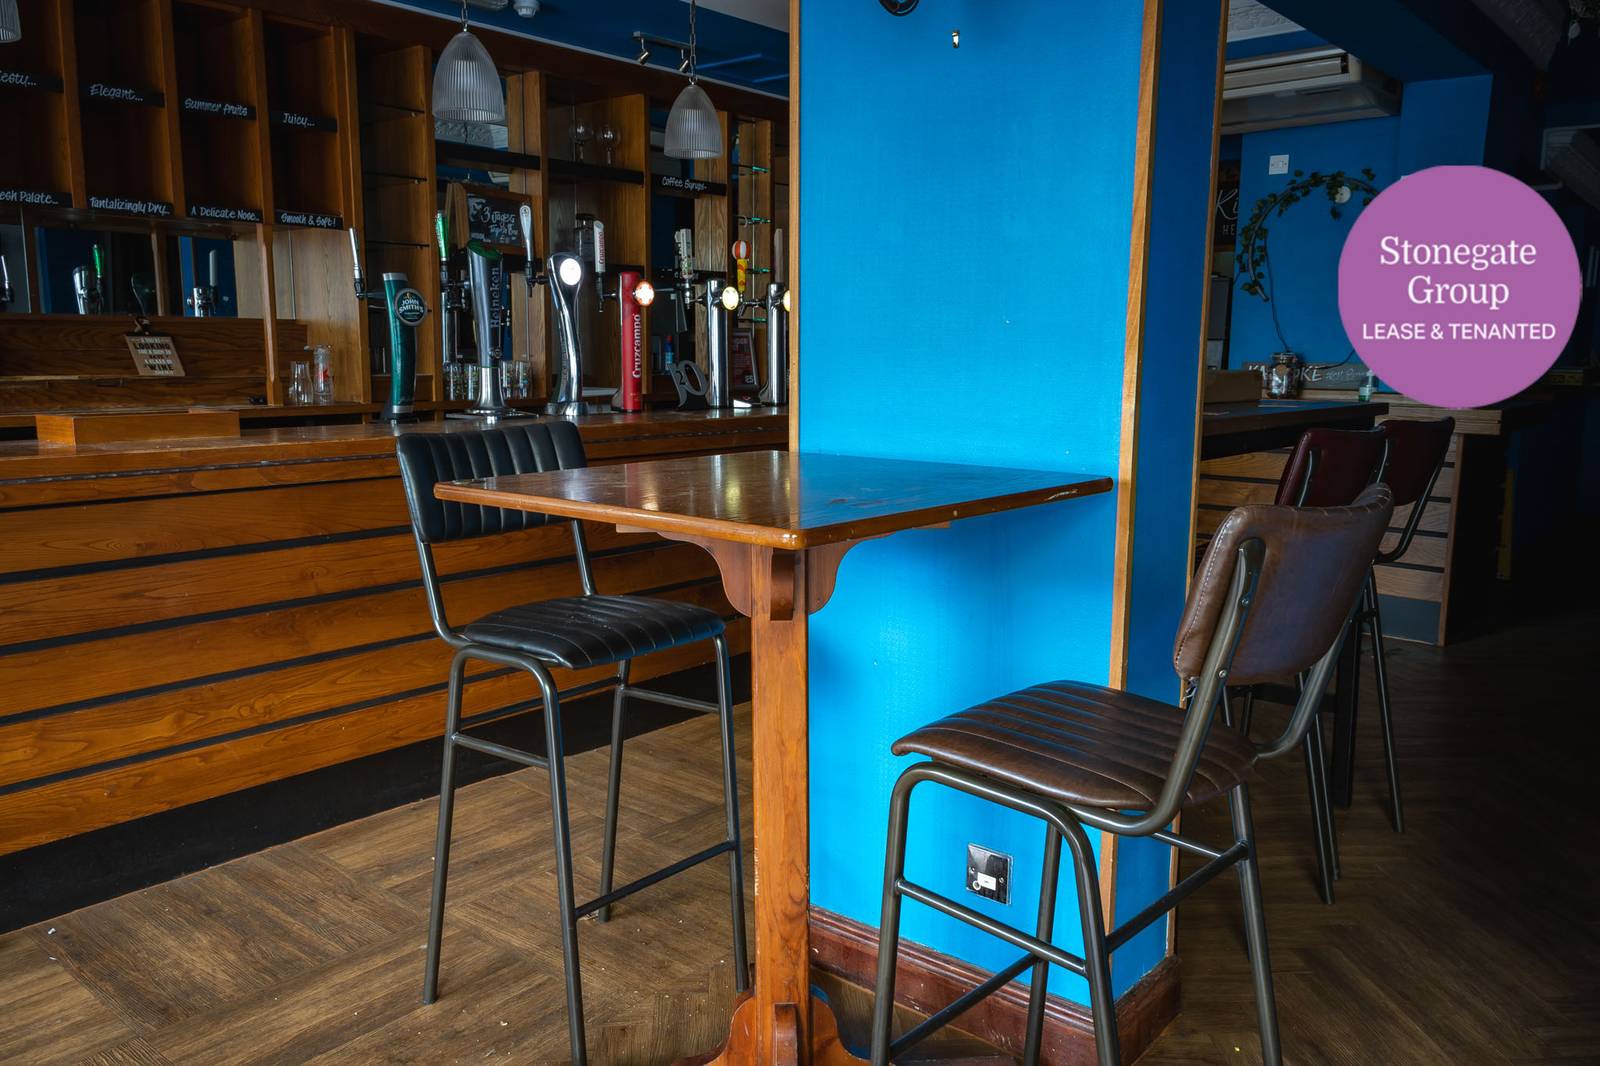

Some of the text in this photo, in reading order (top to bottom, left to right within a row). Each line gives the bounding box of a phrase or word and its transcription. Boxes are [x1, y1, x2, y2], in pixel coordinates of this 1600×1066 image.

[661, 176, 683, 188] Coffee
[190, 205, 197, 216] A
[199, 206, 237, 219] Delicate
[281, 212, 307, 225] Smooth
[308, 214, 316, 226] &
[401, 298, 420, 307] JOHN
[632, 313, 641, 379] Cruzcampo
